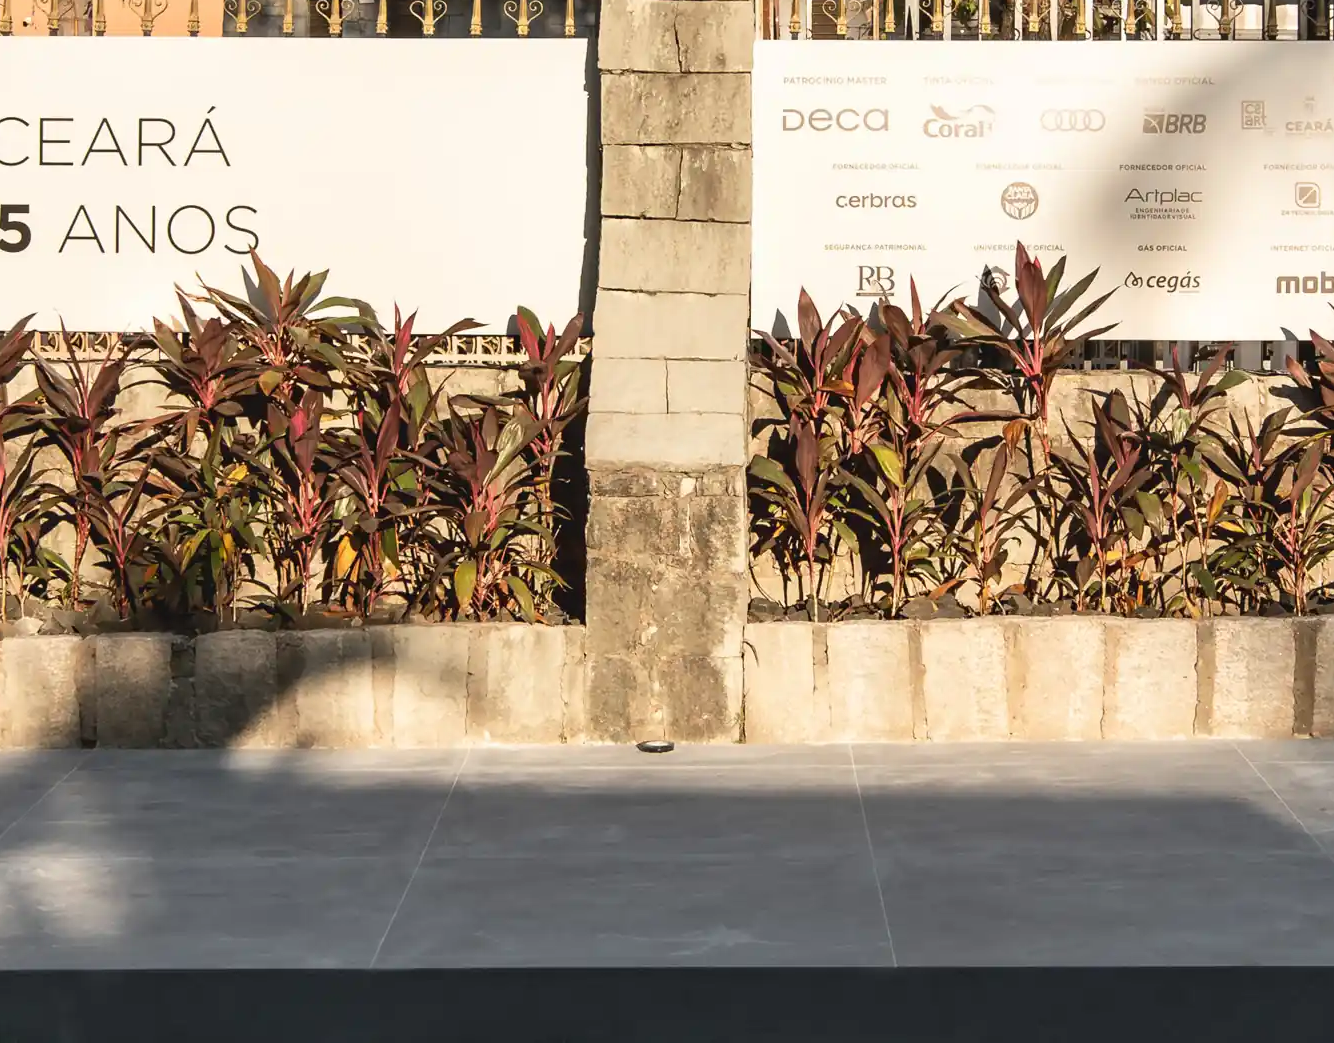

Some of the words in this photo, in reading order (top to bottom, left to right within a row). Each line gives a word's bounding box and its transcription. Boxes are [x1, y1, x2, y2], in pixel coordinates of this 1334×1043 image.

[923, 118, 985, 138] Coral
[1164, 113, 1207, 134] BRB
[1285, 118, 1334, 132] CEARÁ
[835, 193, 918, 209] cerbras
[1124, 188, 1204, 205] Artplac
[58, 205, 259, 255] ANOS
[1033, 244, 1066, 252] OFICIAL
[1137, 243, 1154, 252] GÁS
[1156, 244, 1188, 252] OFICIAL
[856, 265, 896, 292] RB
[1146, 271, 1201, 293] cegás
